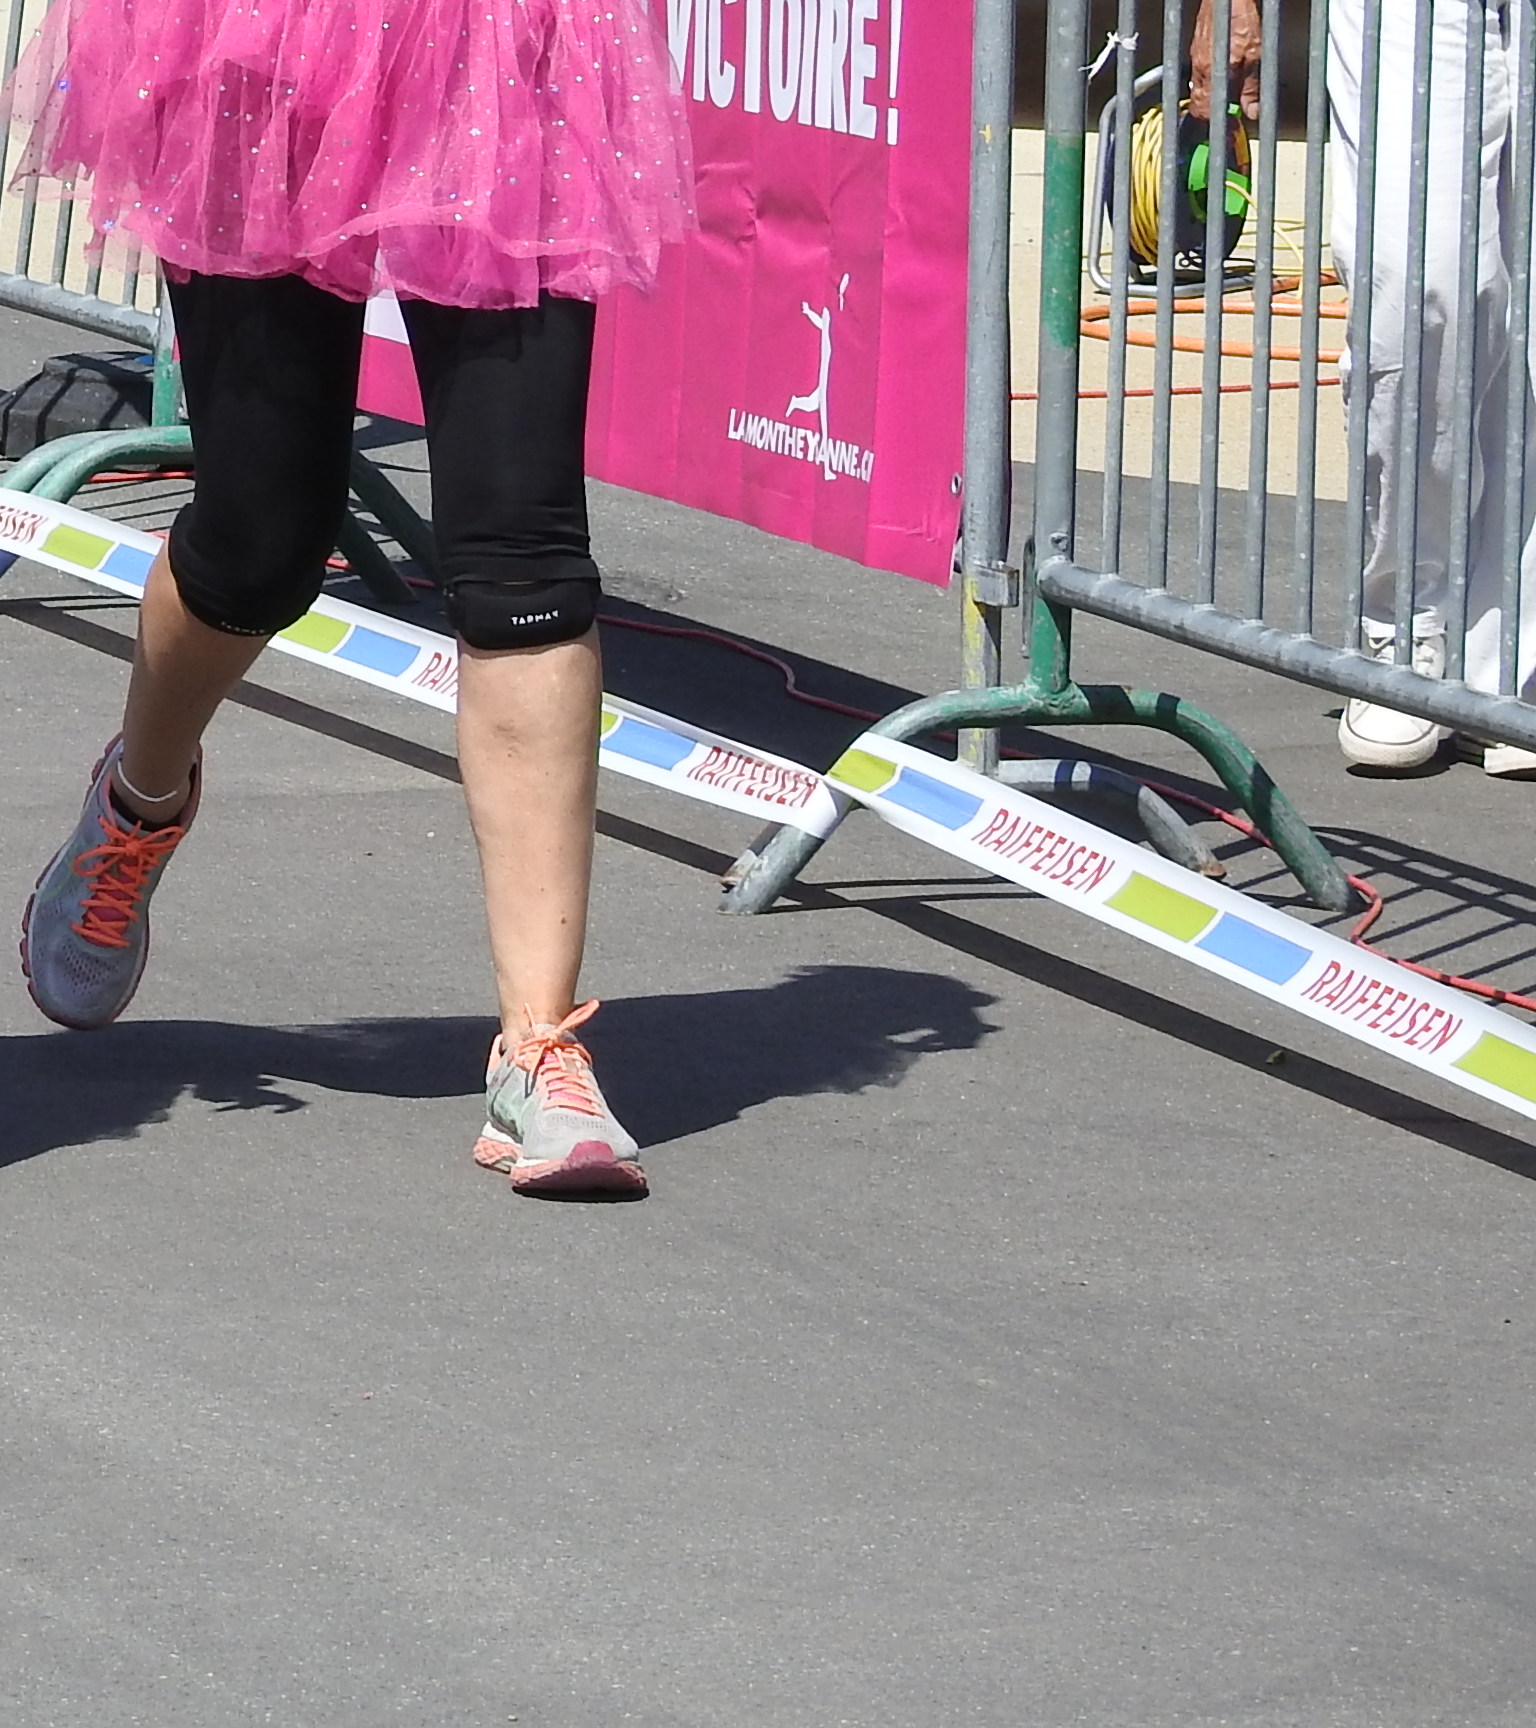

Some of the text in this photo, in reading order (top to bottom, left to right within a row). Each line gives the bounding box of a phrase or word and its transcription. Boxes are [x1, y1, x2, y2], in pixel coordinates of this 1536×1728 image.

[687, 745, 820, 809] RAIFFEISEN
[970, 808, 1116, 894] RAIFFEISEN
[1300, 960, 1464, 1055] RAIFFEISEN
